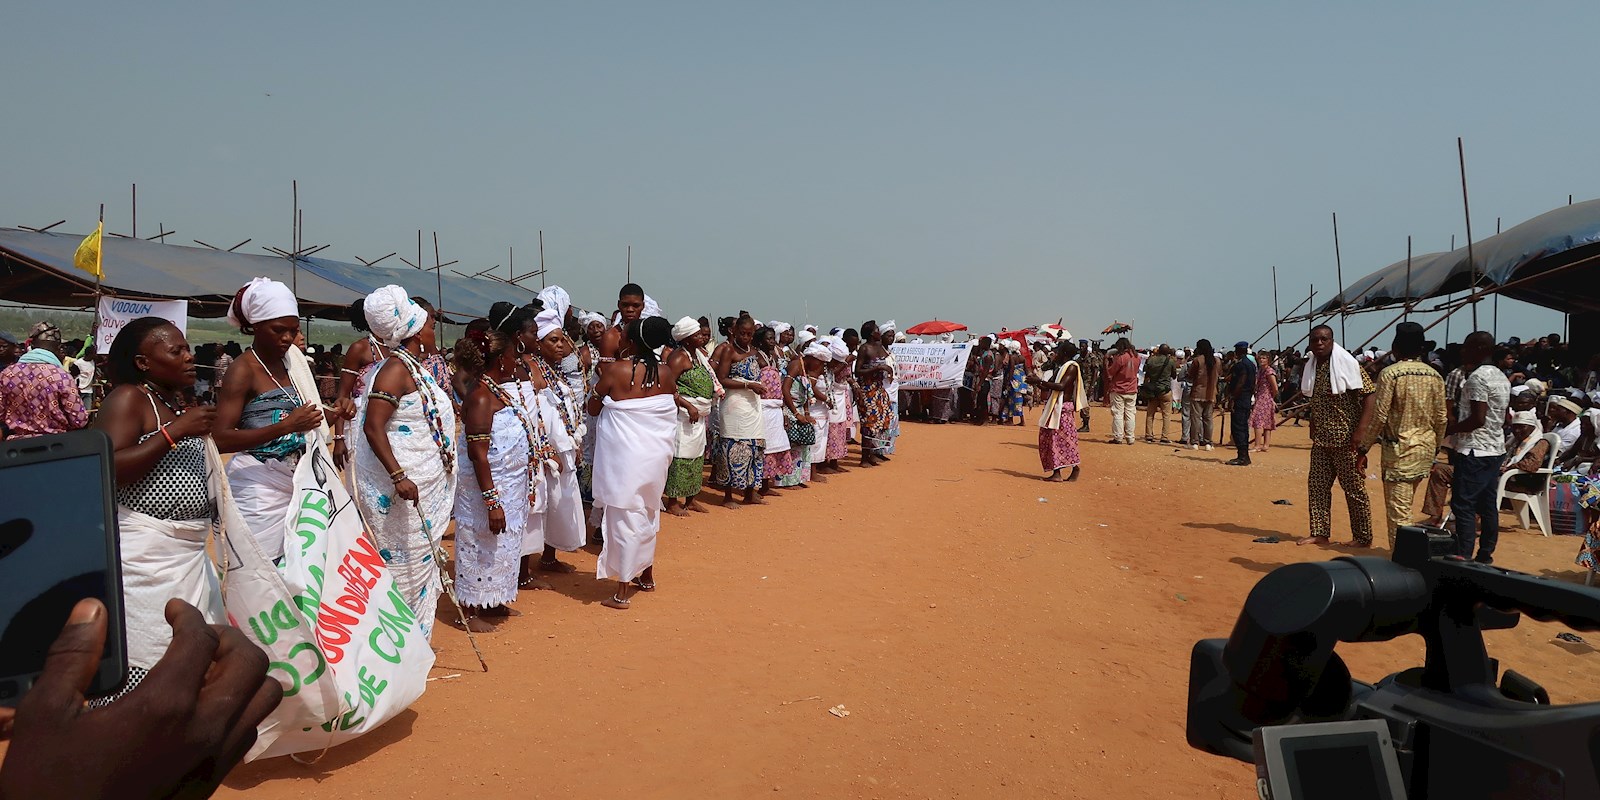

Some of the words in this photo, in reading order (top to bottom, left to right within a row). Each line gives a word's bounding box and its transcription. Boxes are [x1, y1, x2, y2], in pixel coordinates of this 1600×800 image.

[112, 300, 153, 314] VODOUN
[102, 314, 126, 329] auve
[927, 348, 946, 356] TOFFA
[358, 666, 388, 709] DE
